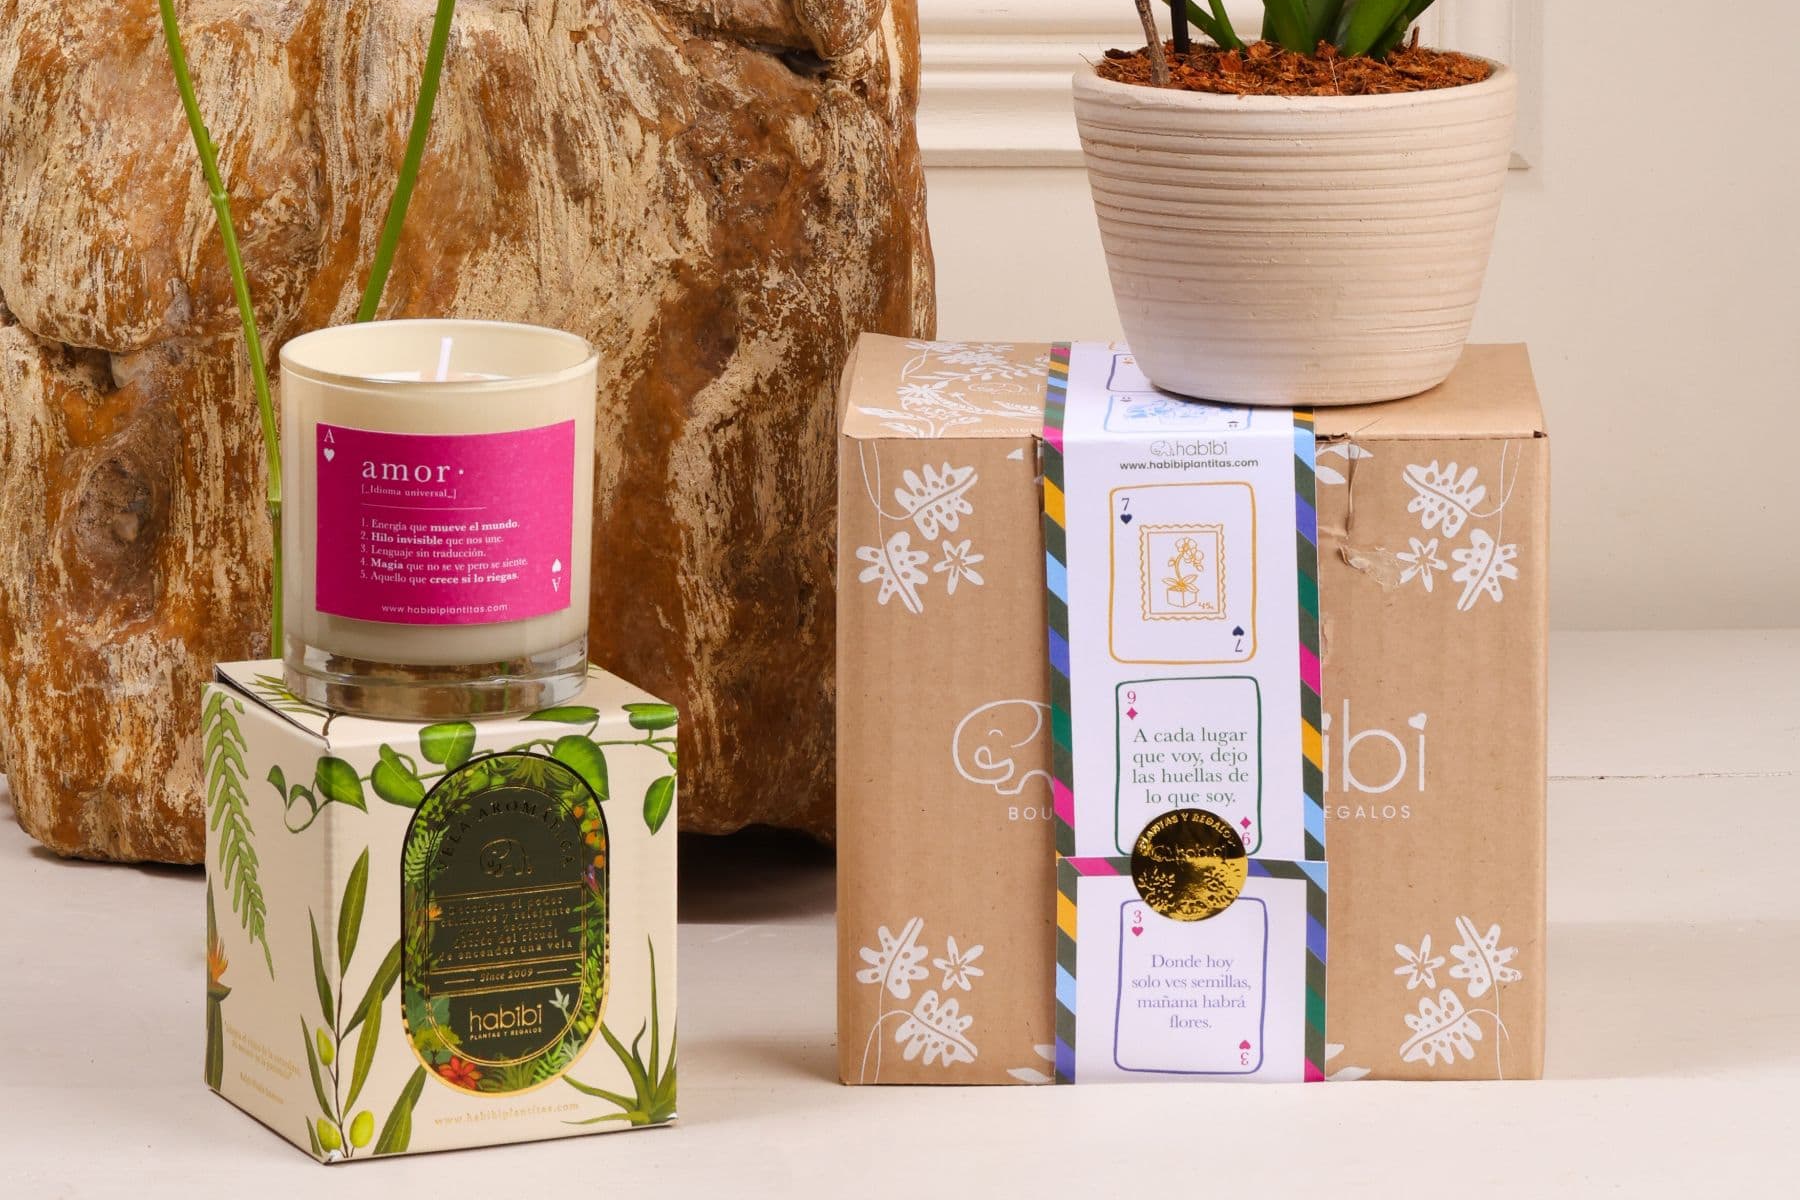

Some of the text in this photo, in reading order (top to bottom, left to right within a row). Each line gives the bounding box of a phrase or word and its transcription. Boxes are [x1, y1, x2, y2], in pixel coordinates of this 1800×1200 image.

[323, 429, 335, 443] A
[1176, 440, 1228, 456] habibi
[1120, 458, 1259, 471] www.habibiplantitas.com
[1121, 498, 1130, 511] 7
[361, 518, 520, 534] 1. Energía que mueve el mundo.
[360, 531, 504, 547] 2. Hilo invisible que nos une.
[360, 544, 486, 559] 3. Lenguaje sin traducción.
[360, 557, 528, 573] 4. Magia que no se ve pero se siente.
[360, 570, 519, 586] 5. Aquello que crece si lo riegas.
[381, 602, 508, 616] www.habibiplantitas.com
[1127, 691, 1137, 705] 9
[1133, 727, 1249, 746] A cada lugar
[1322, 698, 1428, 795] ibi
[1133, 748, 1248, 767] que voy, dejo
[1133, 769, 1249, 784] las huellas de
[1146, 789, 1236, 807] lo que soy.
[1008, 805, 1411, 820] BOU EGALOS
[1133, 910, 1142, 924] 3
[1151, 954, 1234, 973] Donde hoy
[480, 968, 534, 982] Since 2009
[1131, 975, 1252, 991] solo ves semillas,
[1137, 995, 1247, 1009] mañana habrá
[469, 1003, 542, 1032] habibi
[1169, 1015, 1213, 1029] flores.
[469, 1031, 500, 1041] PLANTAS
